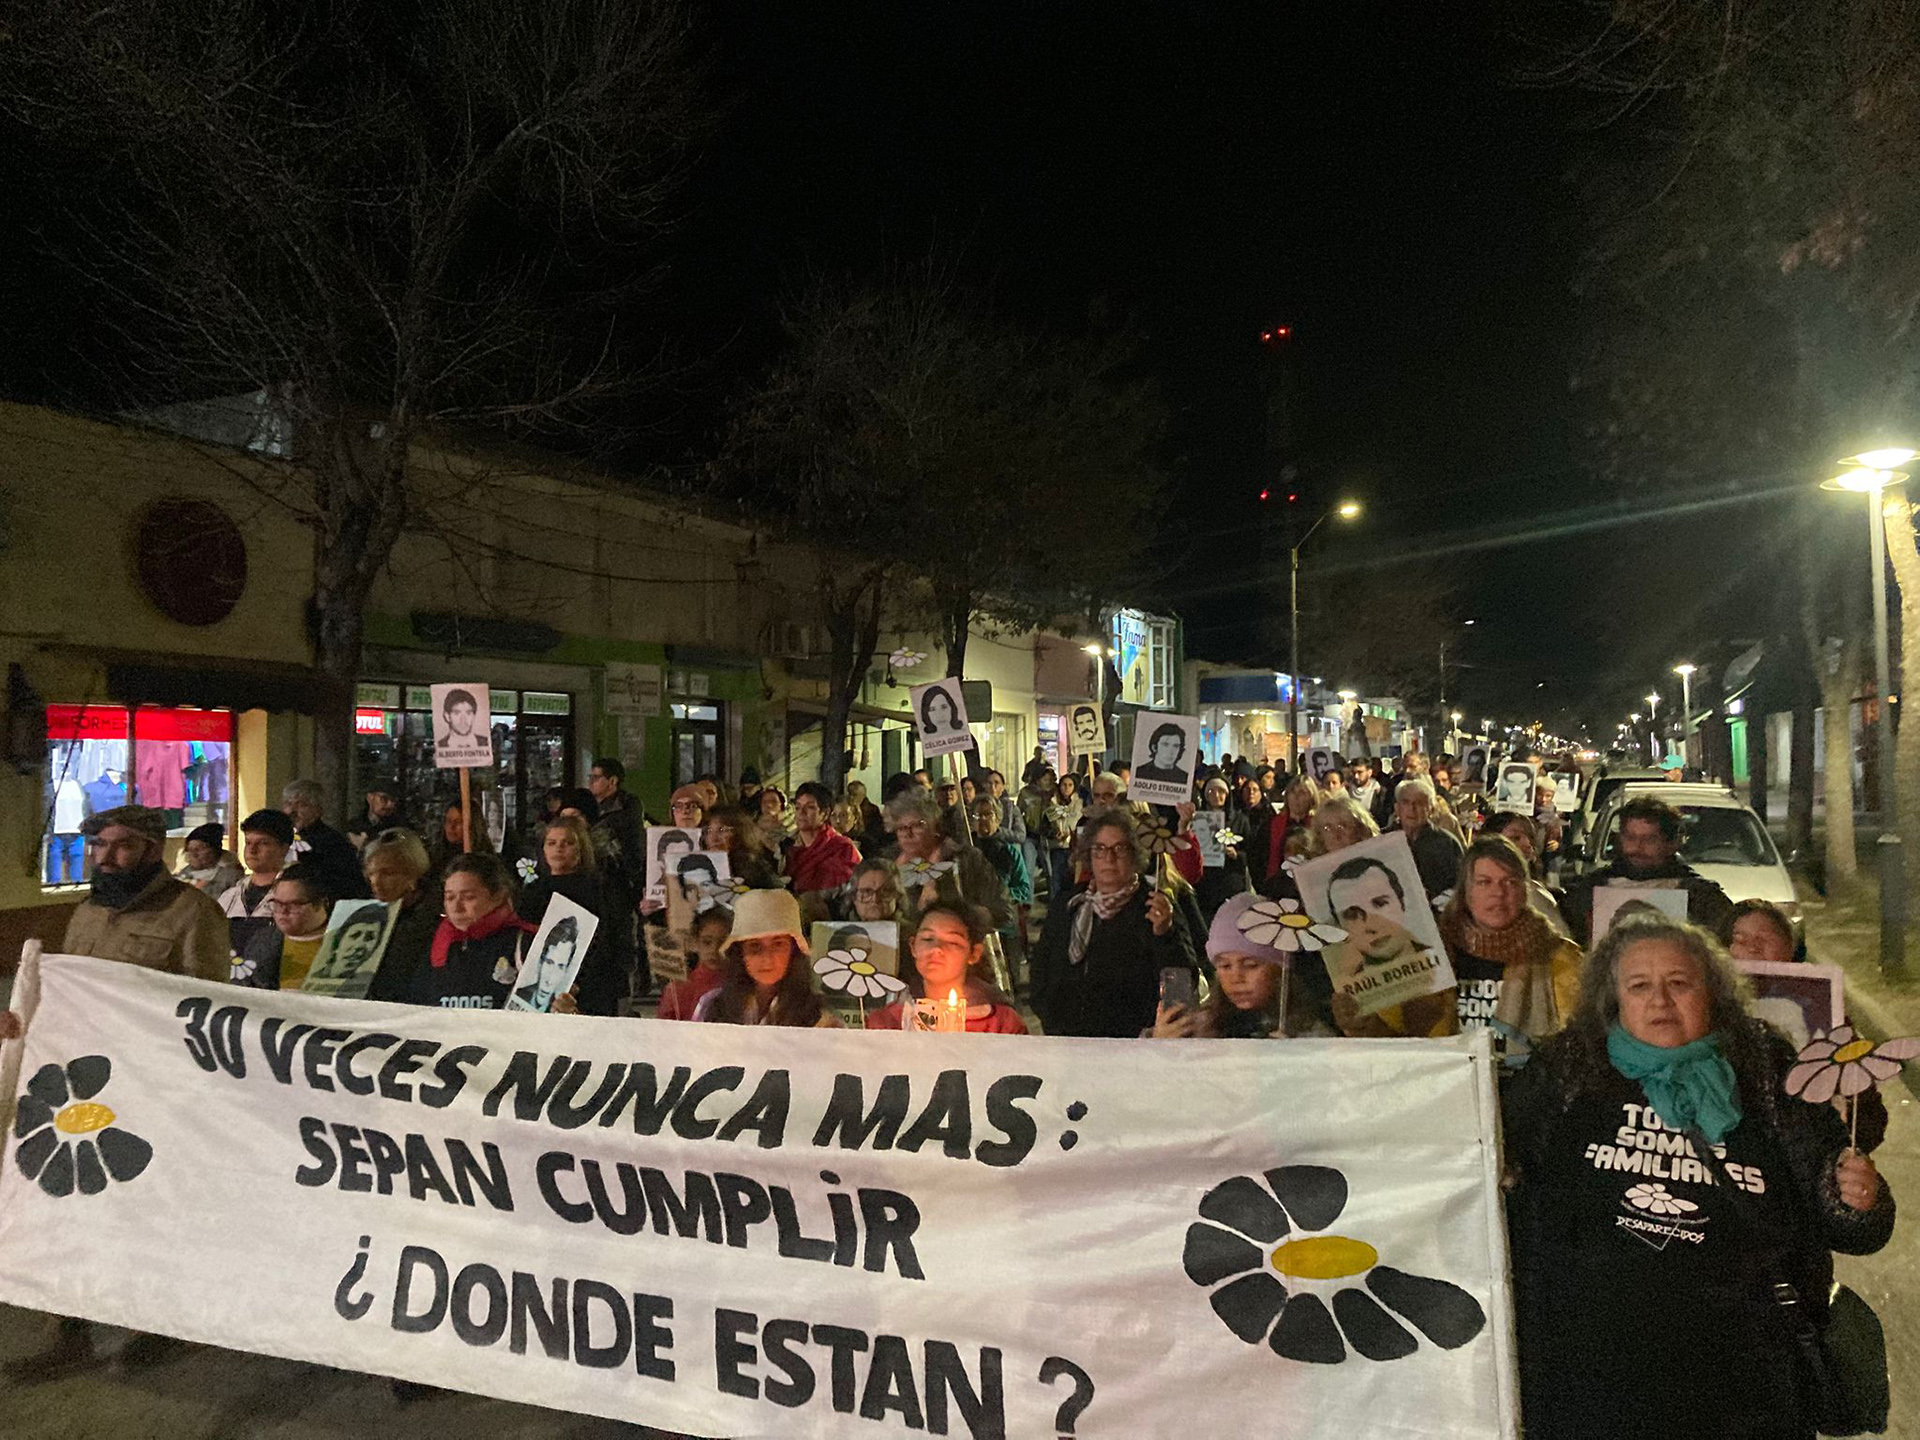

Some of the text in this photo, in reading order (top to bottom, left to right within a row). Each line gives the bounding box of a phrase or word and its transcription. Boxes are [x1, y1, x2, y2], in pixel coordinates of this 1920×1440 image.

[356, 716, 383, 730] OTUL
[947, 735, 970, 745] GOMEZ
[438, 750, 464, 758] ALBERTO
[1133, 780, 1158, 792] ADOLFO
[1157, 783, 1188, 795] STROMAN
[1382, 954, 1442, 984] BORELLI
[174, 996, 247, 1079] 30
[259, 1017, 488, 1109] VECES
[482, 1053, 790, 1150] NUNCA
[296, 1116, 515, 1212] SEPAN
[1615, 1215, 1705, 1245] DESAPARECIDOS
